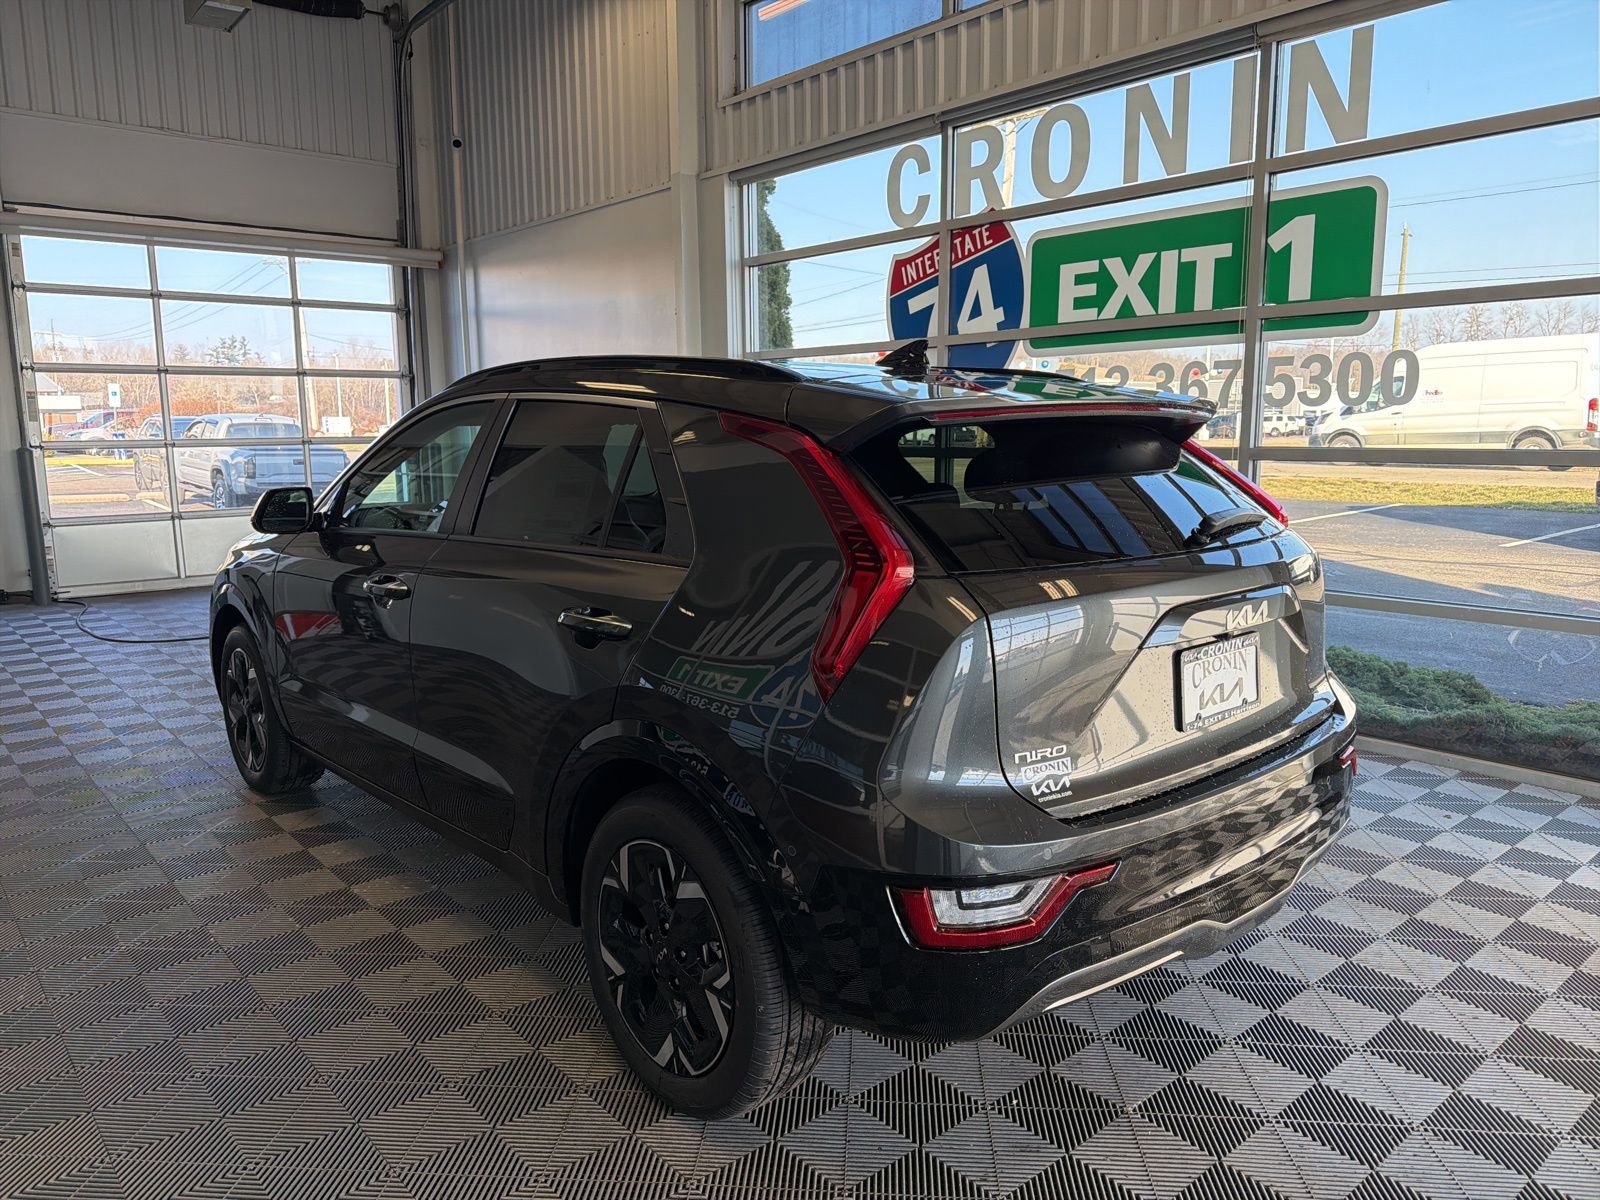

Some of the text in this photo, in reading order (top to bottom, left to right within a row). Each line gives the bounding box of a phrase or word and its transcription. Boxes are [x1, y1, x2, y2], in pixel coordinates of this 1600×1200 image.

[886, 24, 1375, 228] CRONIN
[902, 225, 993, 286] INTERTATE
[1058, 214, 1316, 324] EXIT 1
[907, 264, 1005, 367] 74
[1226, 600, 1268, 630] KIA
[1201, 638, 1243, 659] CRONIN
[1192, 650, 1248, 688] CRONIN
[1199, 677, 1244, 710] KIA
[1204, 714, 1222, 725] EXIT
[1015, 745, 1067, 764] NIRO
[1024, 760, 1069, 780] CRONIN
[1031, 776, 1071, 796] KIA
